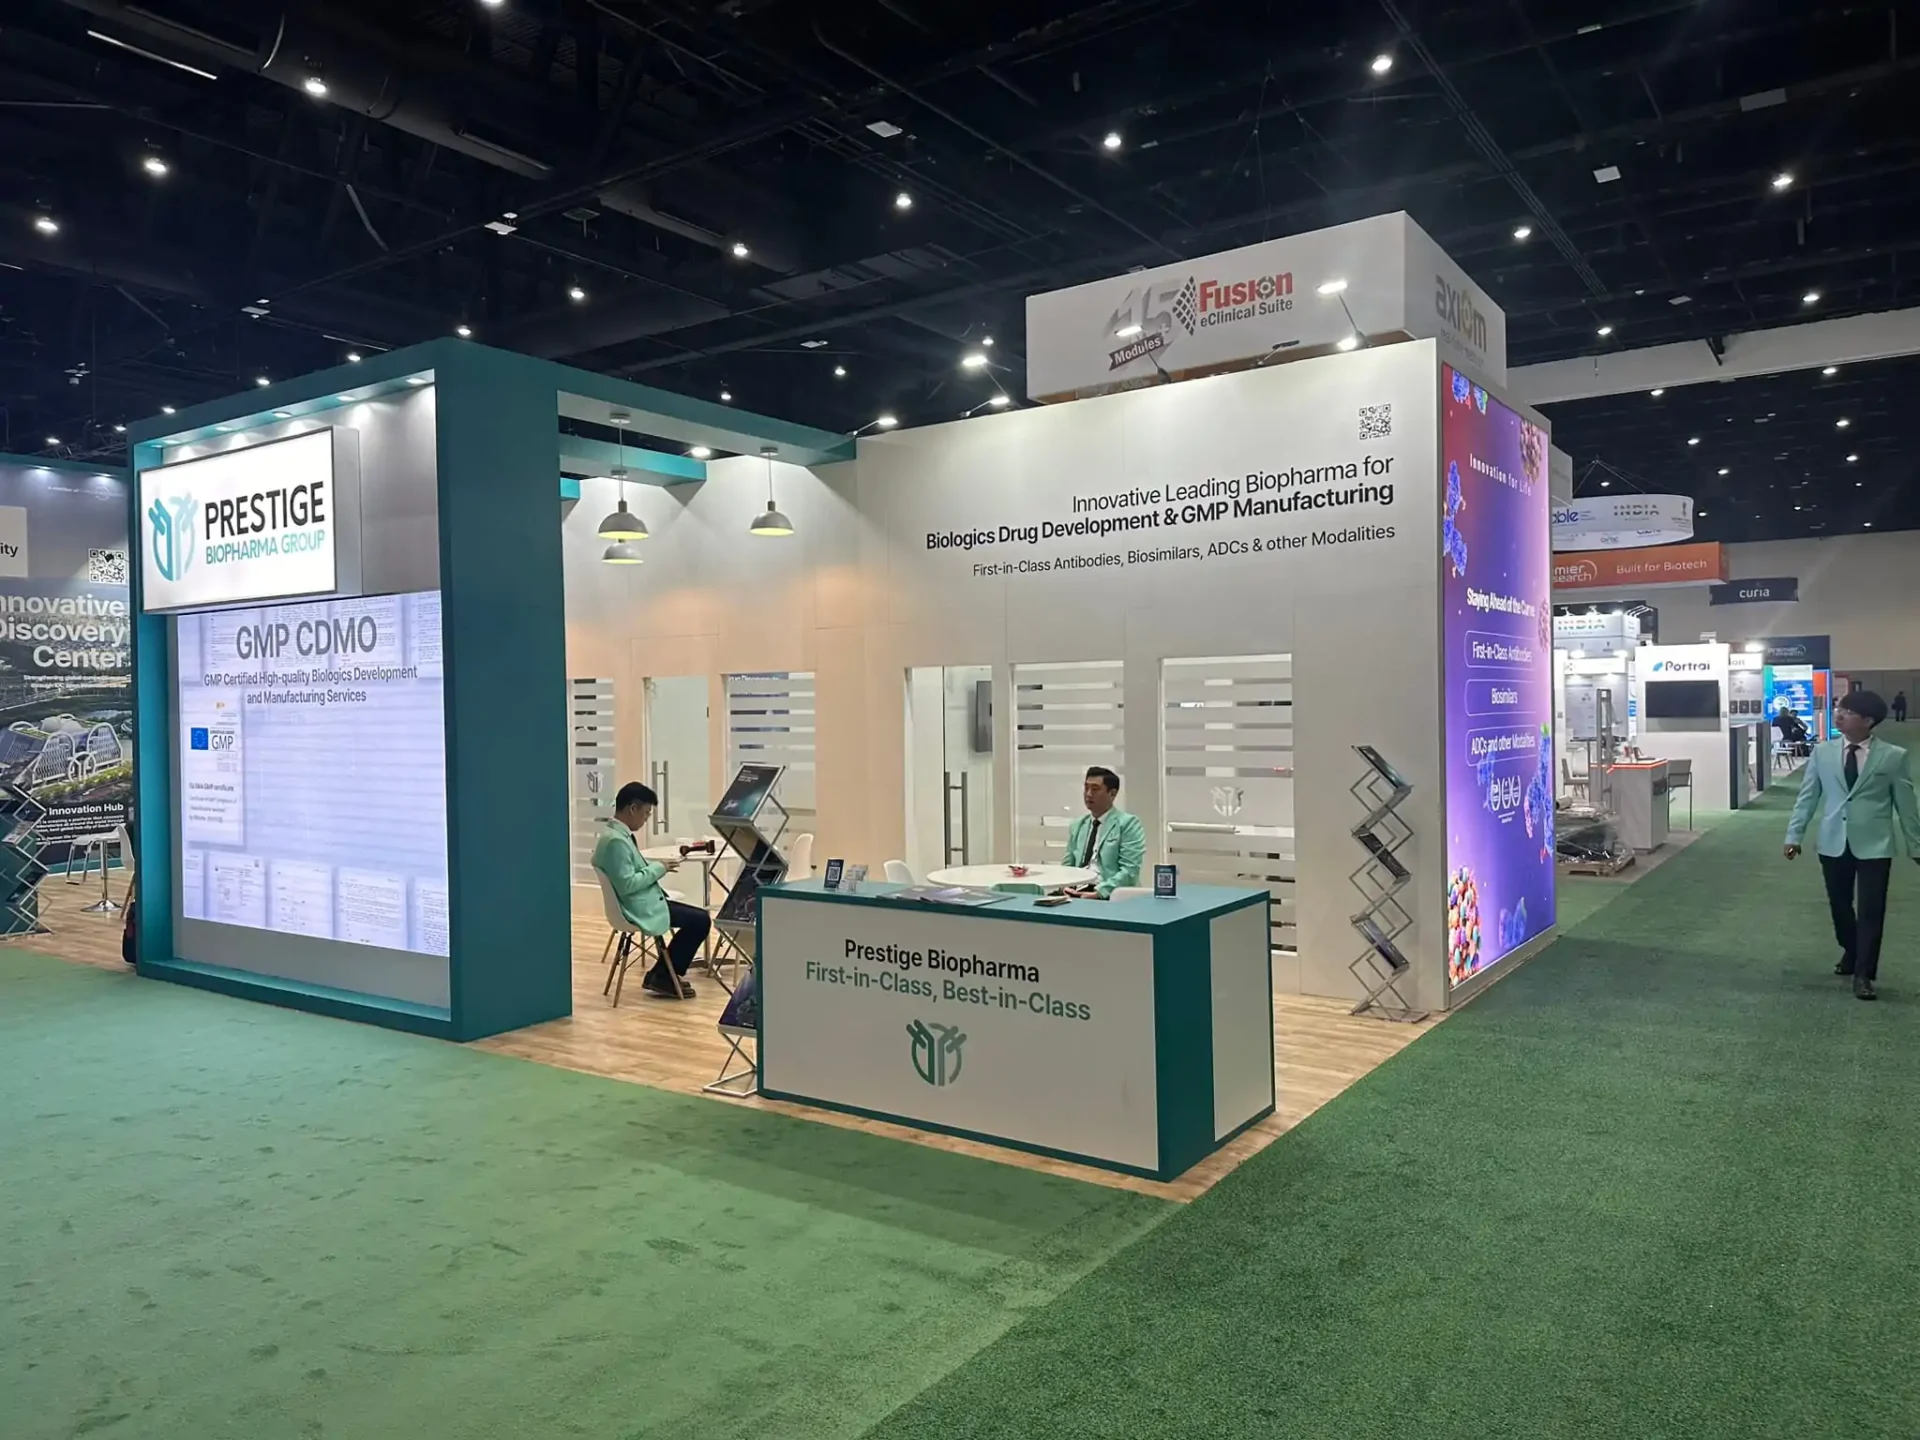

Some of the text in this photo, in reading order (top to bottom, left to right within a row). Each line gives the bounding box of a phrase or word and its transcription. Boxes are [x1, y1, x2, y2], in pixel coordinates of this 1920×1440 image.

[1199, 272, 1293, 313] Fusion
[1200, 298, 1293, 328] eClinical Suite
[1436, 274, 1487, 353] axiom
[1115, 336, 1161, 364] Modules
[1073, 455, 1394, 513] Innovative Leading Biopharma for
[1469, 453, 1532, 496] Innovation for Life
[205, 481, 325, 540] PRESTIGE
[926, 482, 1394, 550] Biologics Drug Development & GMP Manufacturing
[206, 529, 326, 564] BIOPHARMA GROUP
[973, 525, 1395, 577] First-in-Class Antibodies, Biosimilars, ADCs & other Modalities
[1616, 560, 1708, 575] Built for Biotech
[1467, 587, 1490, 613] Staying
[1490, 592, 1507, 611] Ahead
[1739, 587, 1770, 598] curia
[236, 623, 290, 660] GMP
[296, 615, 378, 657] CDMO
[1472, 641, 1508, 661] First-in-Class
[33, 645, 126, 668] Center
[1665, 660, 1711, 672] Portrai
[204, 665, 418, 688] GMP Certified High-quality Biologics Development
[247, 688, 367, 706] and Manufacturing Services
[211, 735, 234, 750] GMP
[1498, 735, 1512, 751] other
[49, 803, 124, 816] Innovation Hub
[845, 939, 1040, 983] Prestige Biopharma
[806, 960, 1091, 1021] First-in-Class, Best-in-Class
